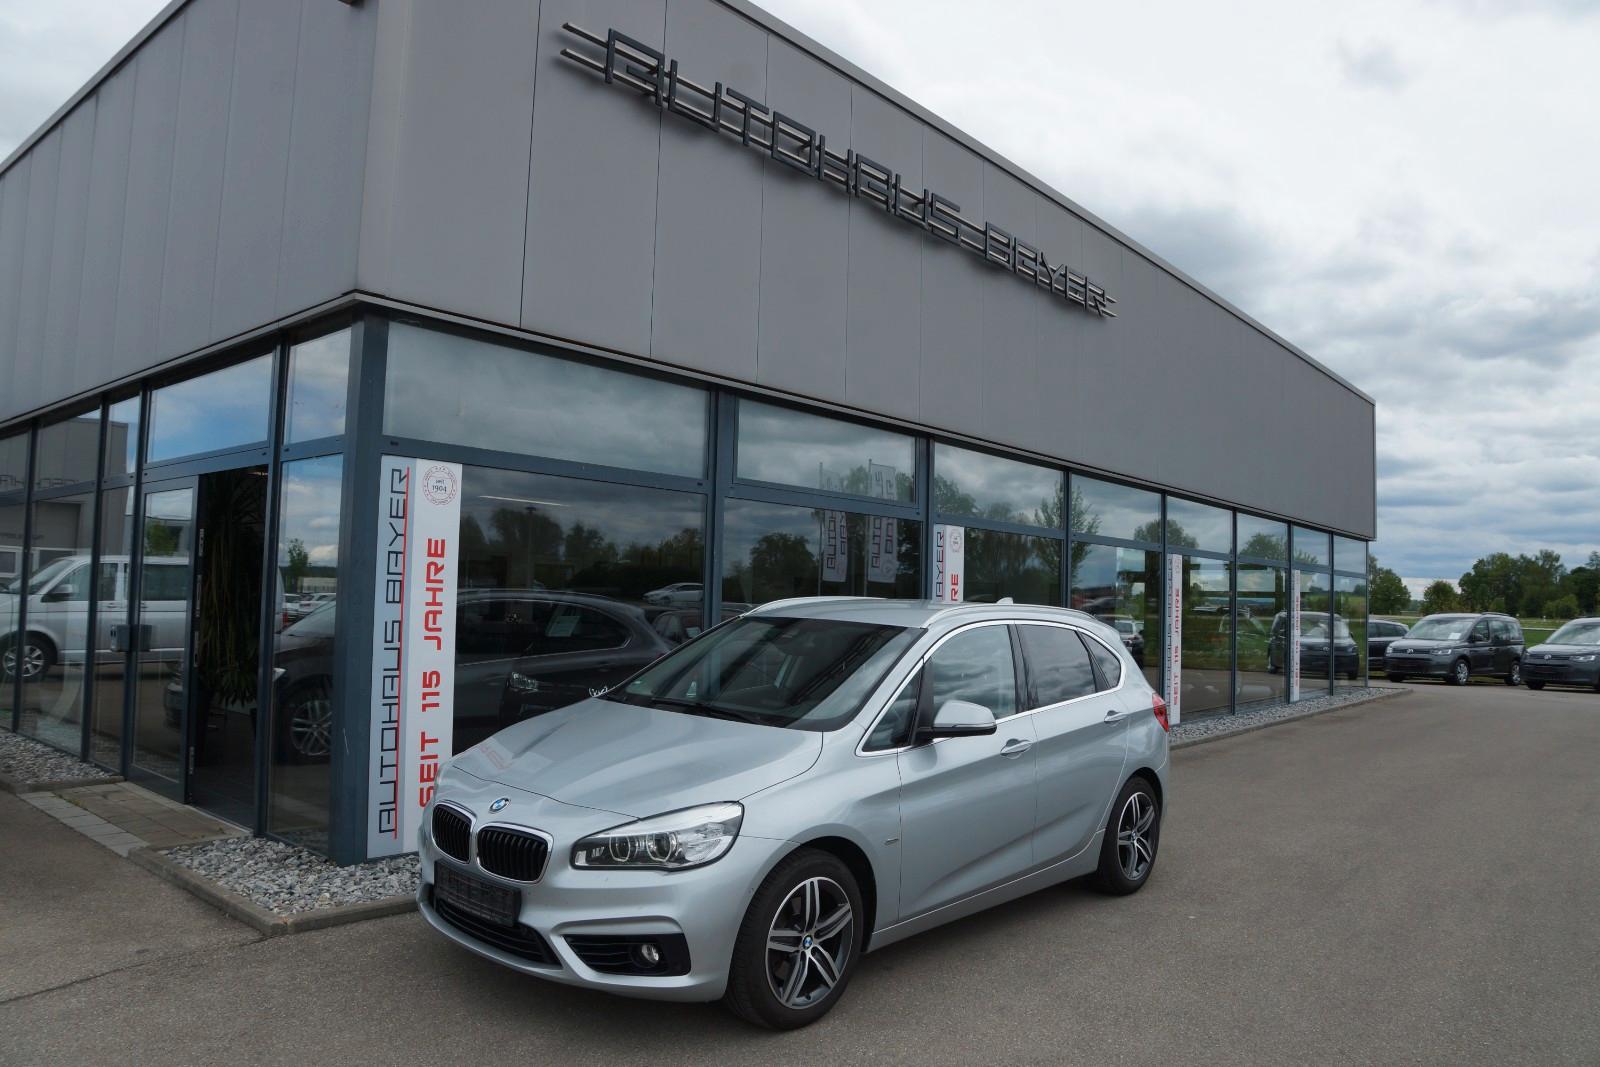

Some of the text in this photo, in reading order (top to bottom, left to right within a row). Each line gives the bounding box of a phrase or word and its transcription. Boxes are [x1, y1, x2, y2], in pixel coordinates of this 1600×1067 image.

[604, 28, 1107, 317] AUTOHAUS BAYER
[432, 485, 447, 493] 1904
[936, 531, 944, 598] AYER
[379, 468, 408, 834] AUTOHAUS BAYER
[418, 538, 446, 808] SEIT 115 JAHRE
